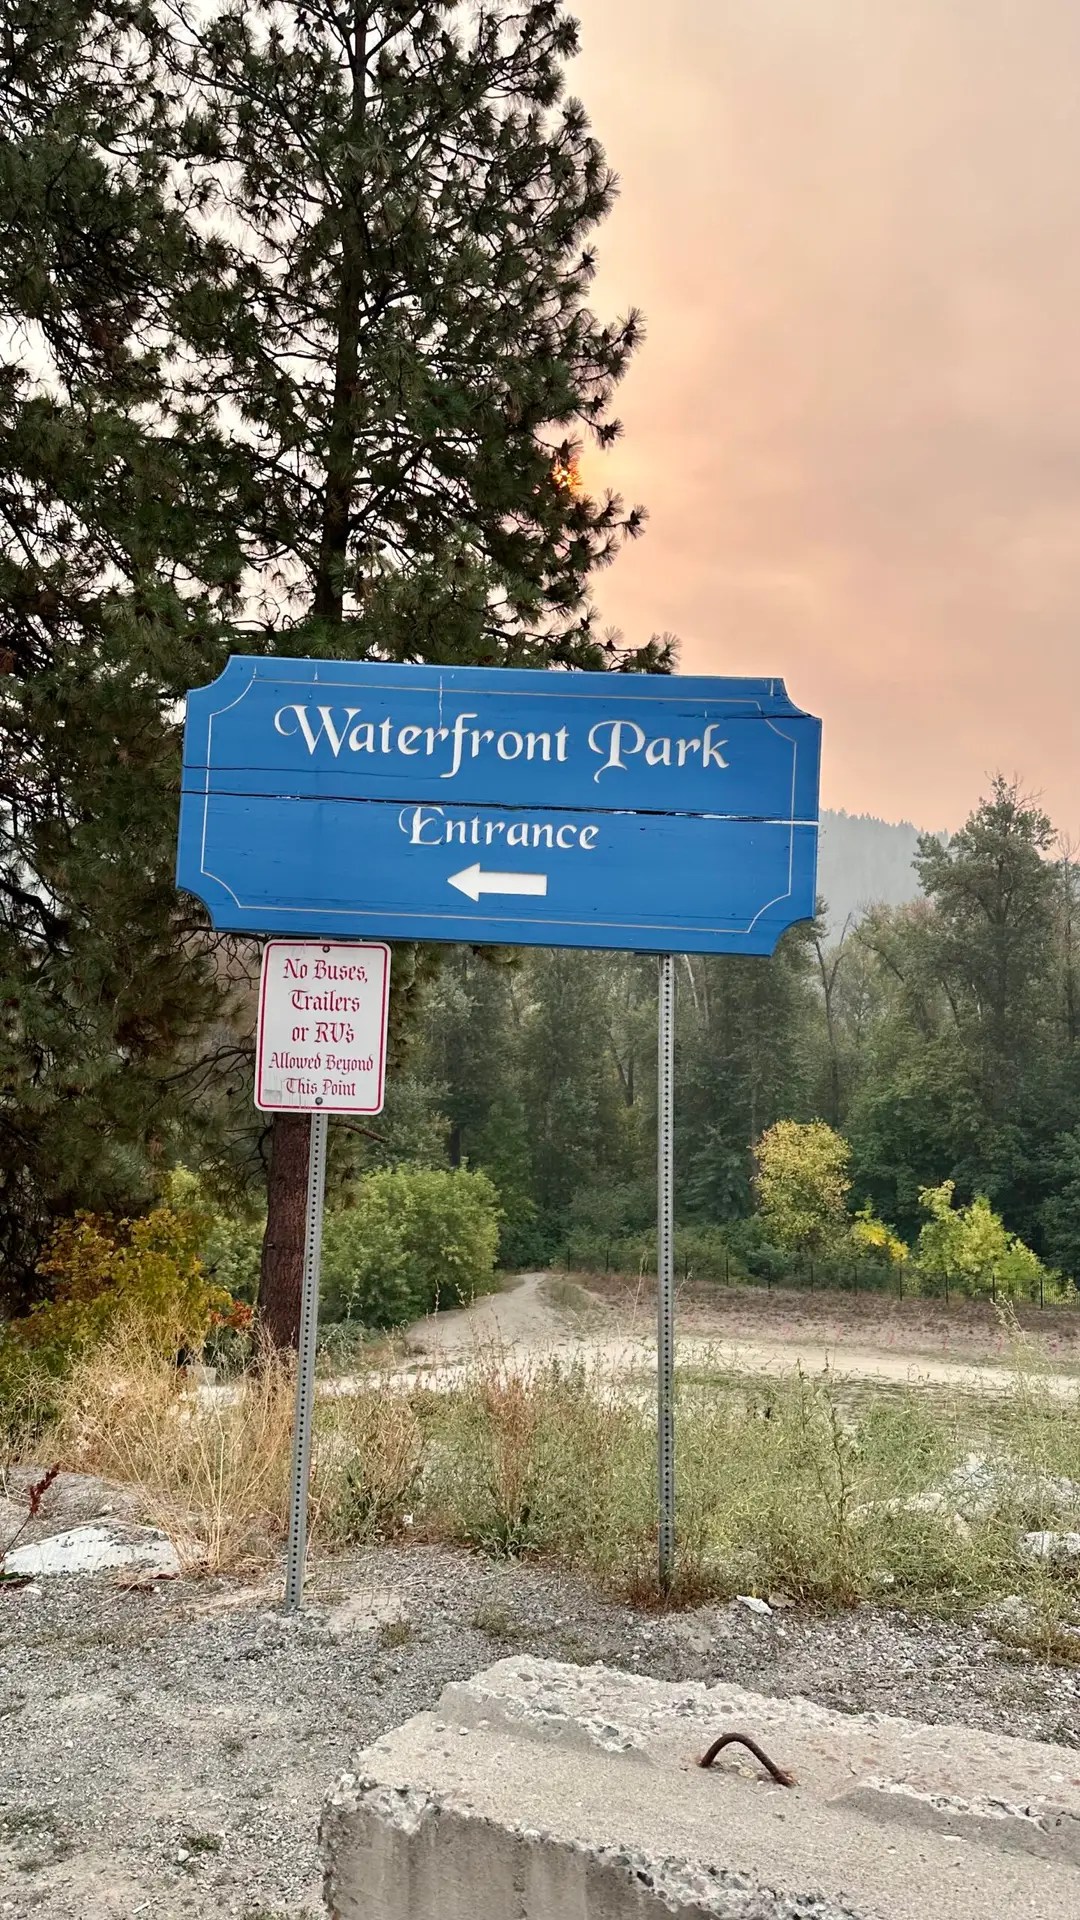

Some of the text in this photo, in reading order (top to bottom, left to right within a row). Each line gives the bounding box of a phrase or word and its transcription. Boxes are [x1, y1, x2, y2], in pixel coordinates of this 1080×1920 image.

[275, 705, 730, 783] Waterfront Park
[399, 806, 600, 849] Entrance
[283, 958, 368, 983] No Buses,
[288, 989, 360, 1012] Trailers
[291, 1026, 309, 1042] or
[268, 1051, 374, 1075] Allowed Beyond
[286, 1077, 356, 1097] This Point
